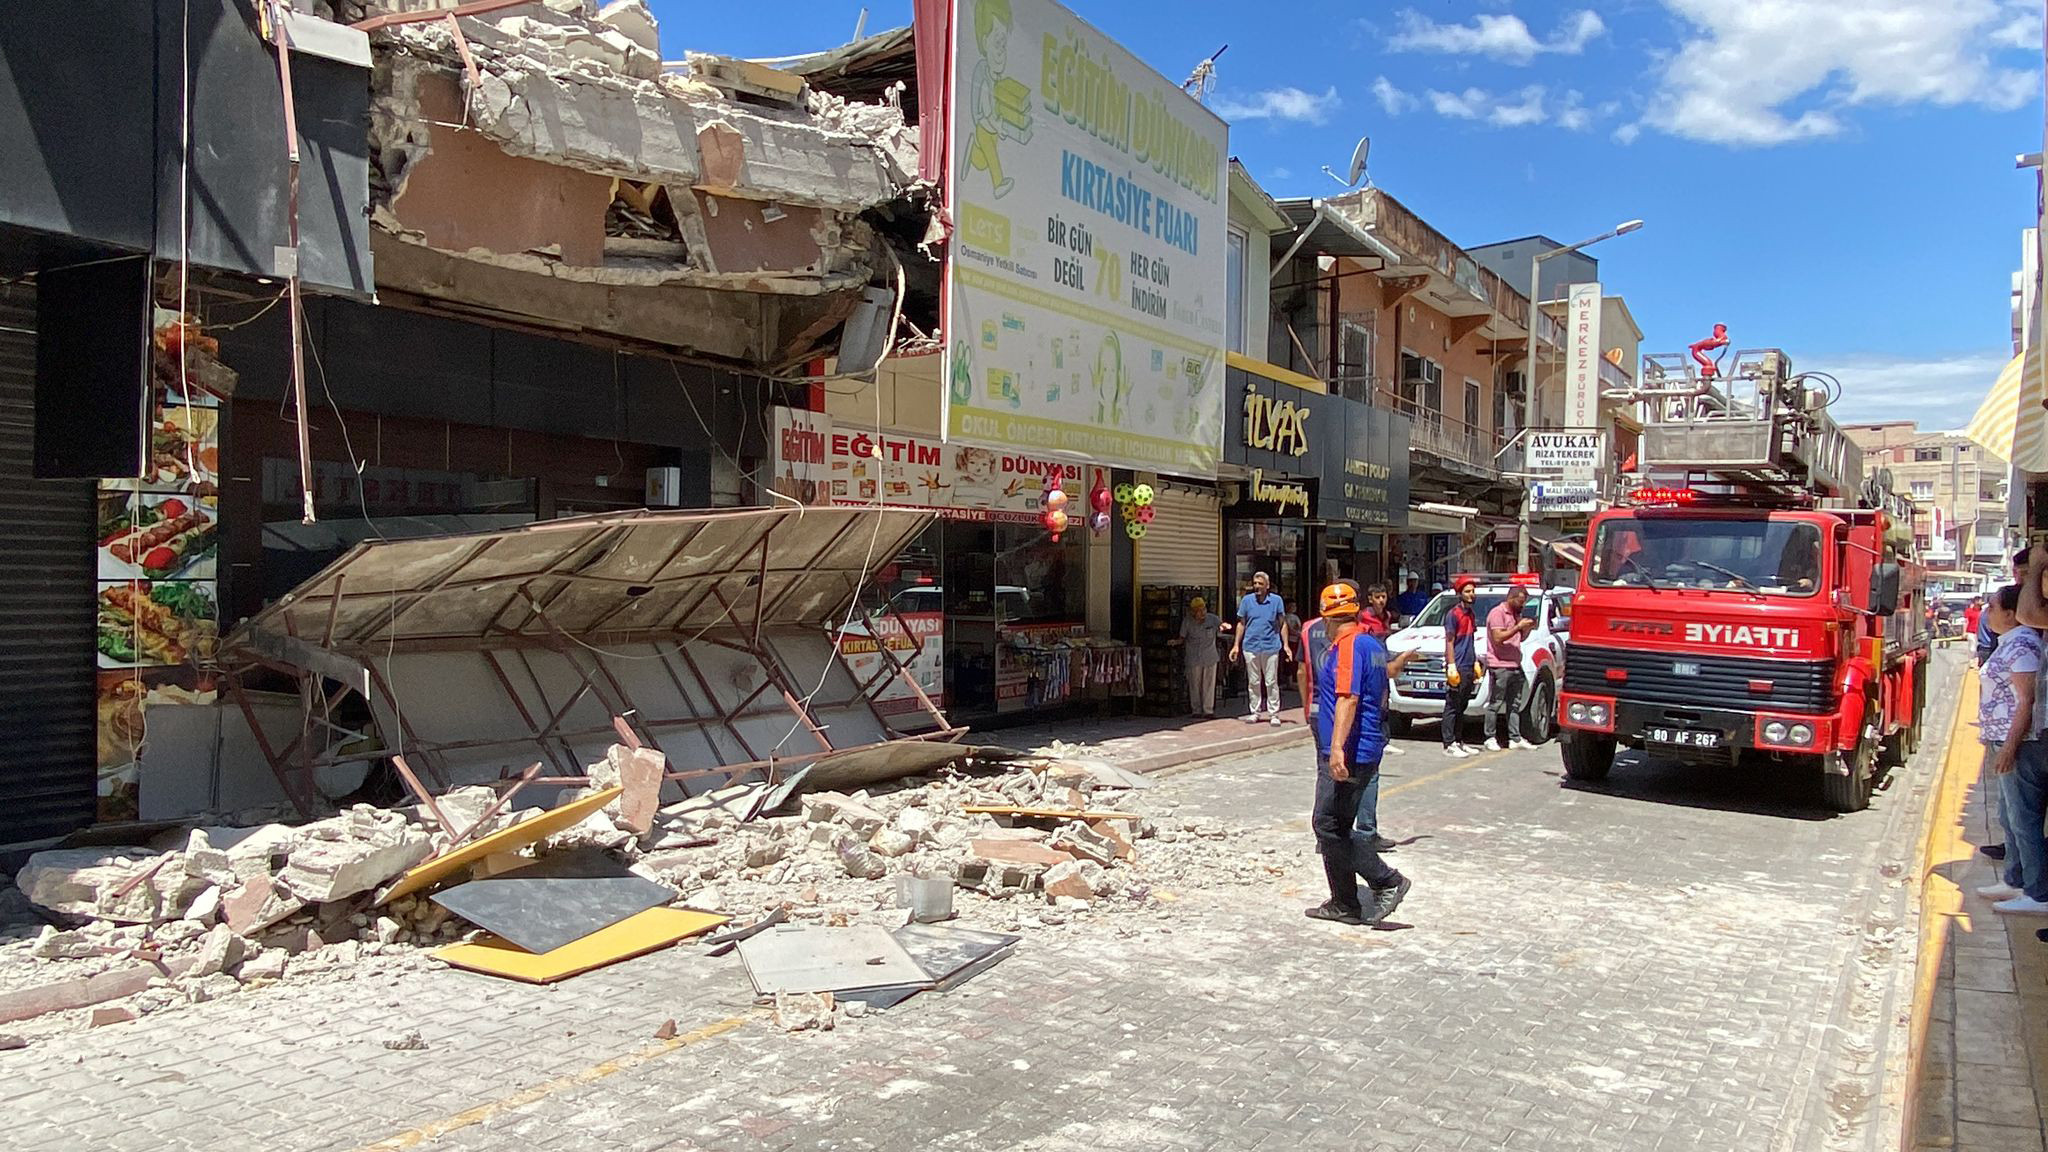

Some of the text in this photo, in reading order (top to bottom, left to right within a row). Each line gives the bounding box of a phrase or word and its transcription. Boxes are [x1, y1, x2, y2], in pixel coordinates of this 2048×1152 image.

[1061, 150, 1198, 256] KIRTASİYE FUARI
[1047, 213, 1066, 248] BİR
[1069, 222, 1092, 258] GÜN
[1053, 255, 1085, 292] DEĞİL
[1130, 251, 1170, 289] HER GÜN
[1131, 285, 1167, 320] İNDİRİM
[1577, 298, 1591, 370] MERKEZ
[961, 414, 1002, 438] OKUL
[1246, 383, 1310, 458] İLYAS
[781, 419, 826, 465] EĞİTİM
[831, 432, 941, 466] EĞİTİM
[1530, 435, 1601, 449] AVUKAT
[1556, 450, 1595, 459] TEKEREK
[1001, 455, 1083, 481] DÜNYASI
[1531, 495, 1555, 505] Zafer
[1415, 680, 1426, 689] 80
[1653, 729, 1717, 747] 80 AF 267
